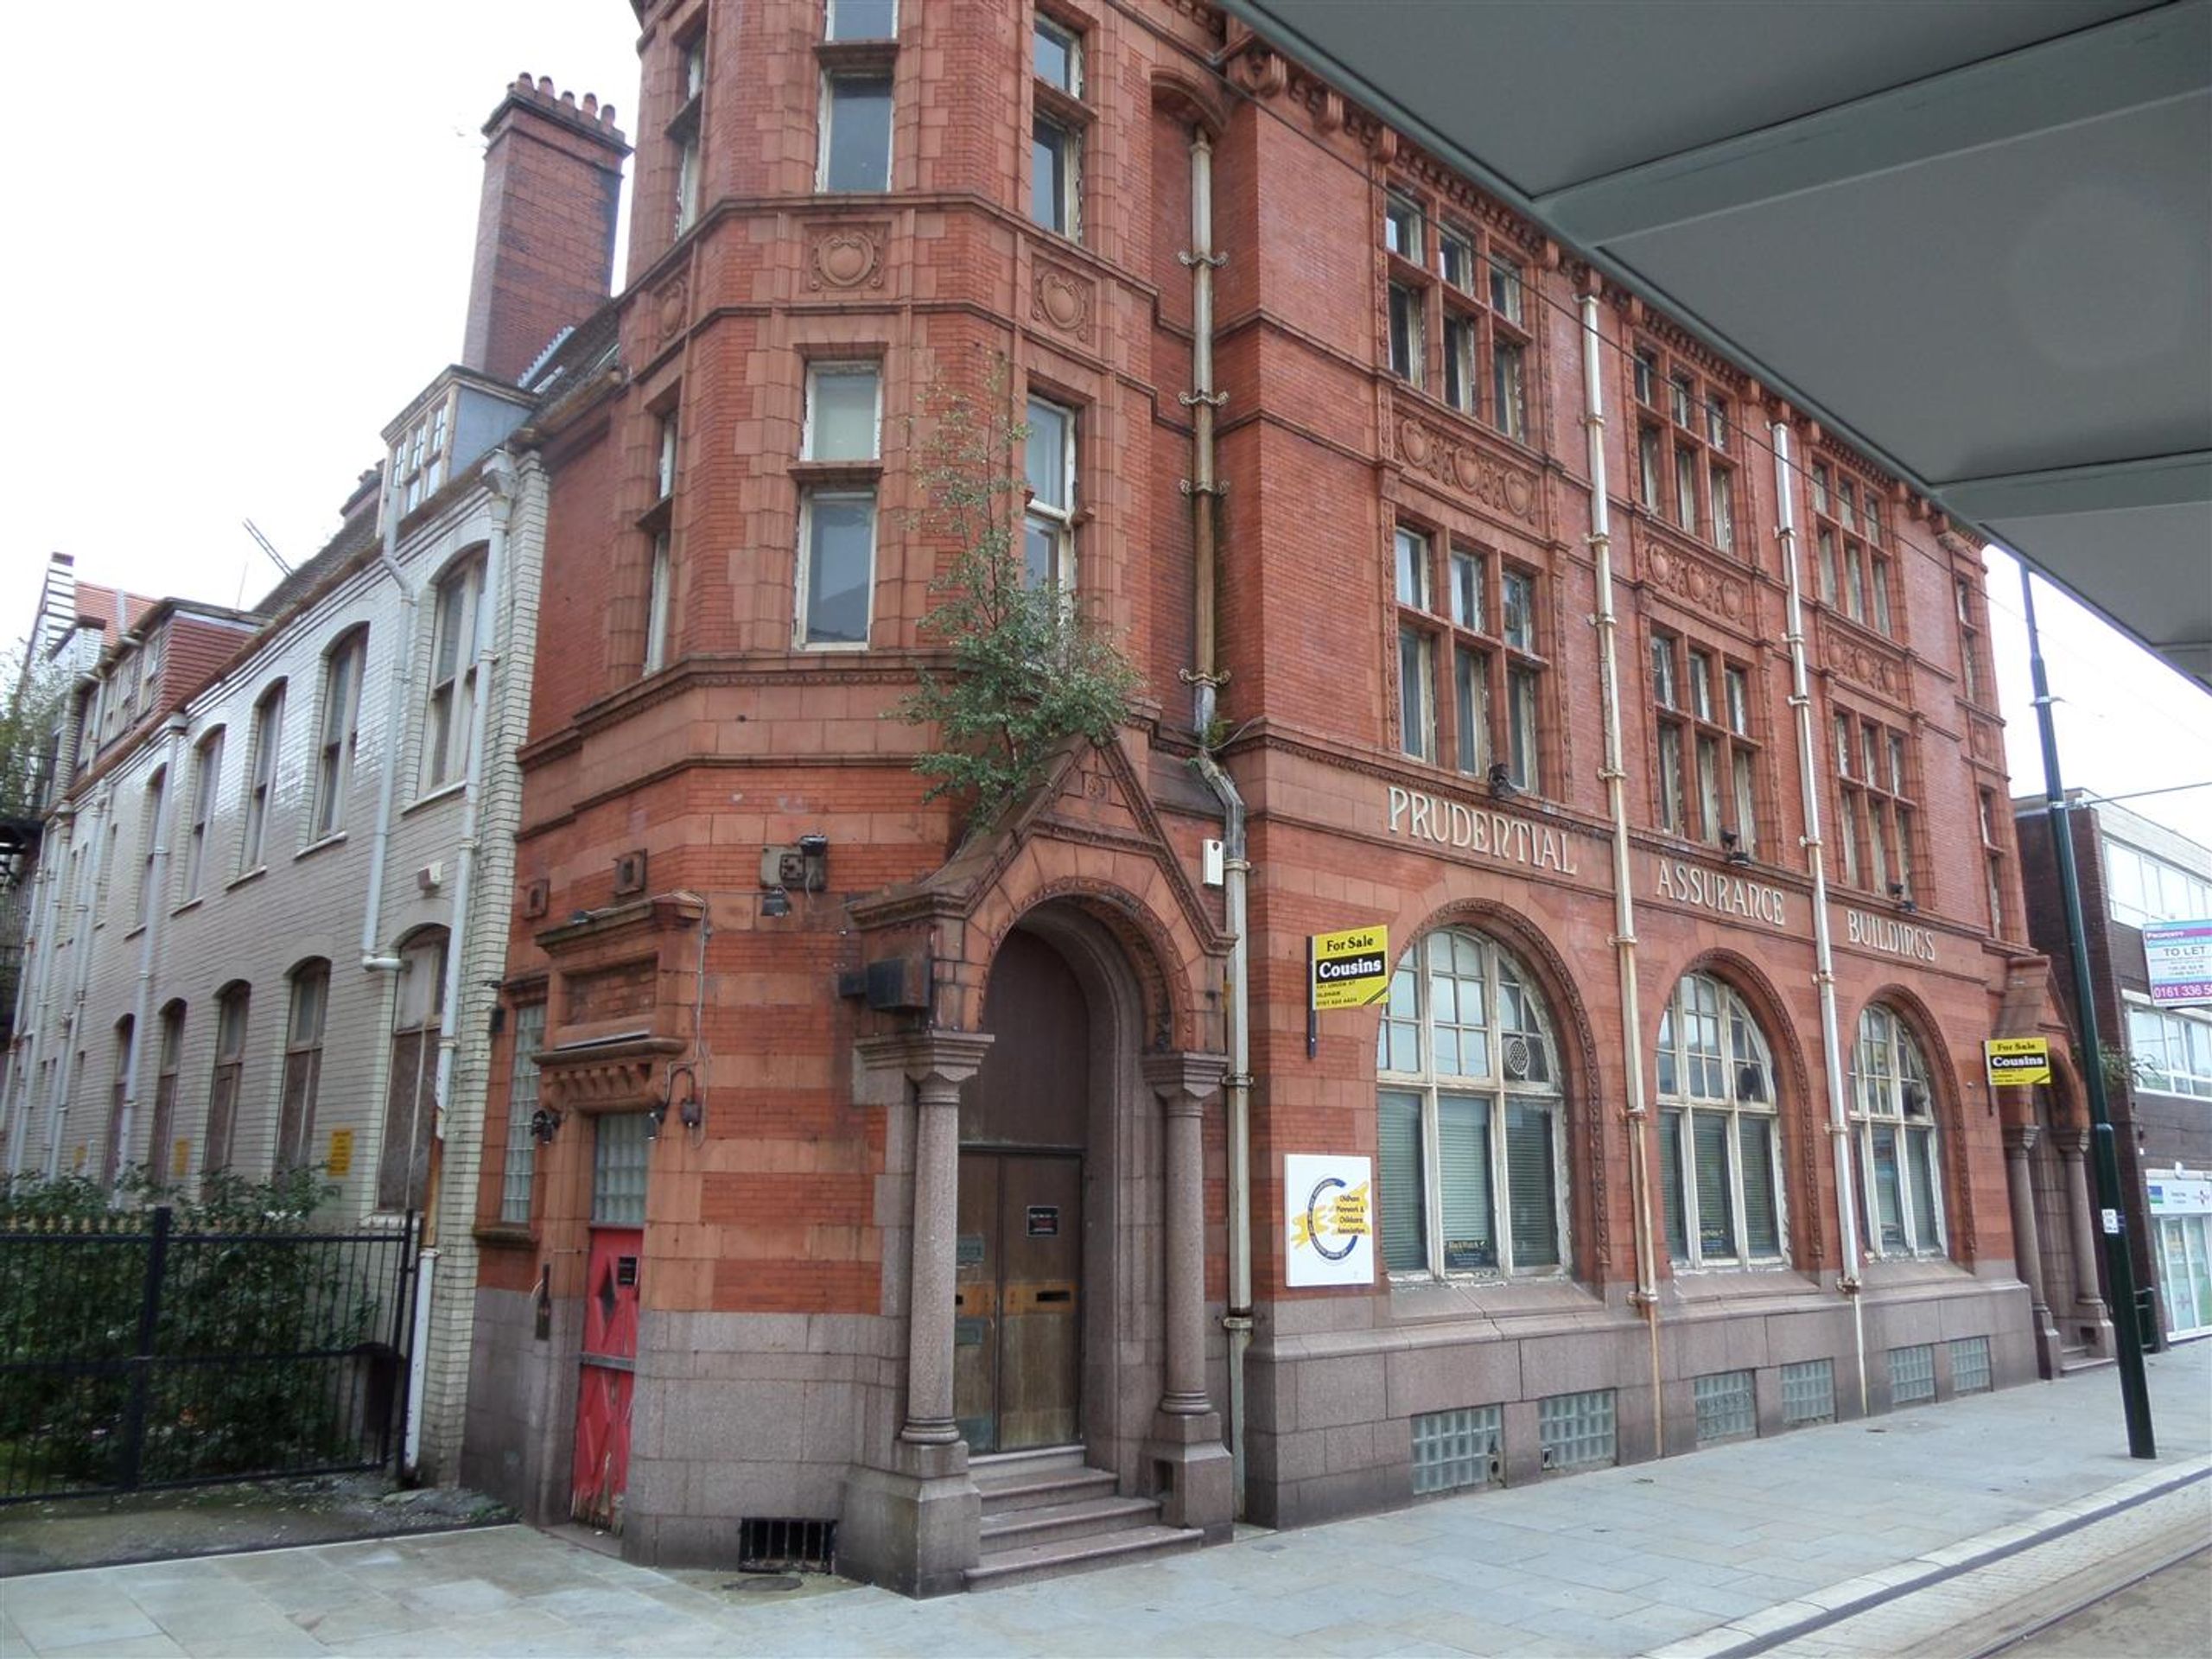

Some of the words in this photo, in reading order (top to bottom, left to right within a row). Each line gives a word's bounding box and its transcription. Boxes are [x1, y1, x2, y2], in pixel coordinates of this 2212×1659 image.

[1389, 786, 1577, 875] PRUDENTIAL
[1656, 860, 1785, 926] ASSURANCE
[1847, 910, 1936, 961] BUILDINGS
[1326, 940, 1345, 951] For
[1348, 935, 1374, 949] Sale
[2164, 948, 2180, 957] TO
[2183, 946, 2205, 955] LET
[1319, 958, 1382, 978] Cousins
[2154, 986, 2179, 998] 0161
[1993, 1056, 2044, 1067] Cousins
